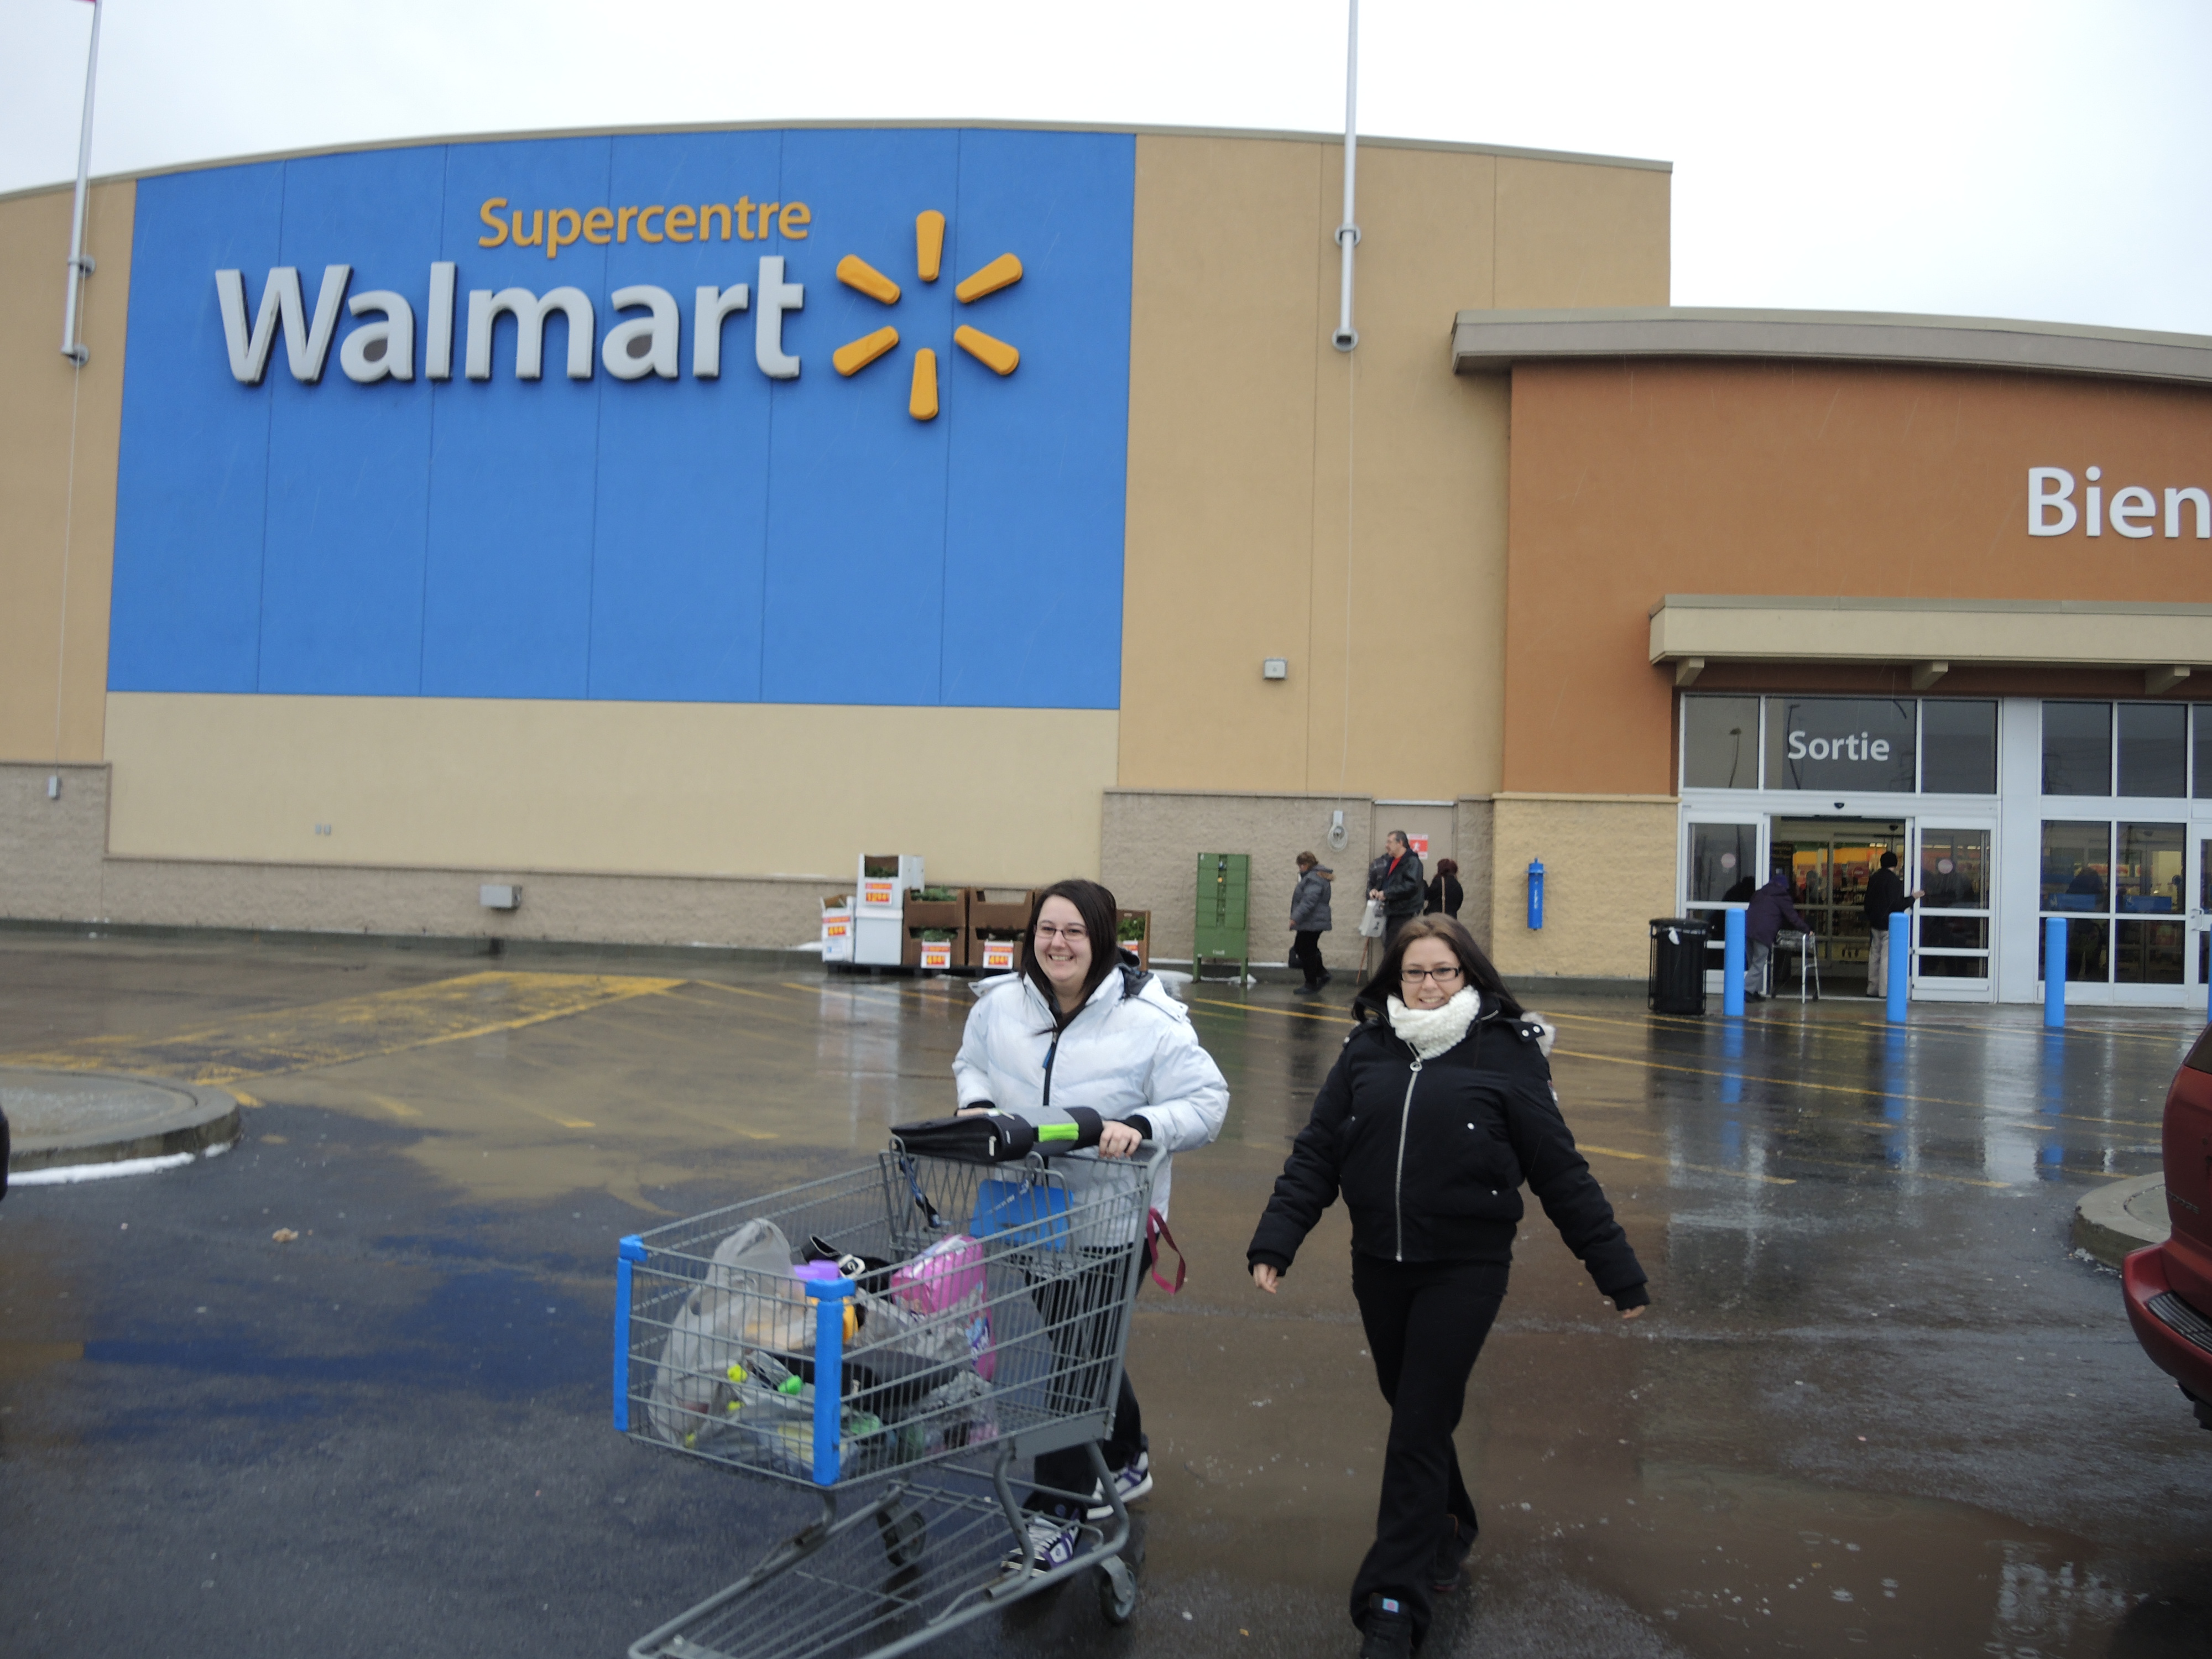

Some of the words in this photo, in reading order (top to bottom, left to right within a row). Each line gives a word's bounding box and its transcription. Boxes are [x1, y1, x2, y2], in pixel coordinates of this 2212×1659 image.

[479, 196, 811, 259] Supercentre
[215, 255, 803, 384] Walmart
[2027, 466, 2211, 539] Bien
[1788, 730, 1890, 761] Sortie
